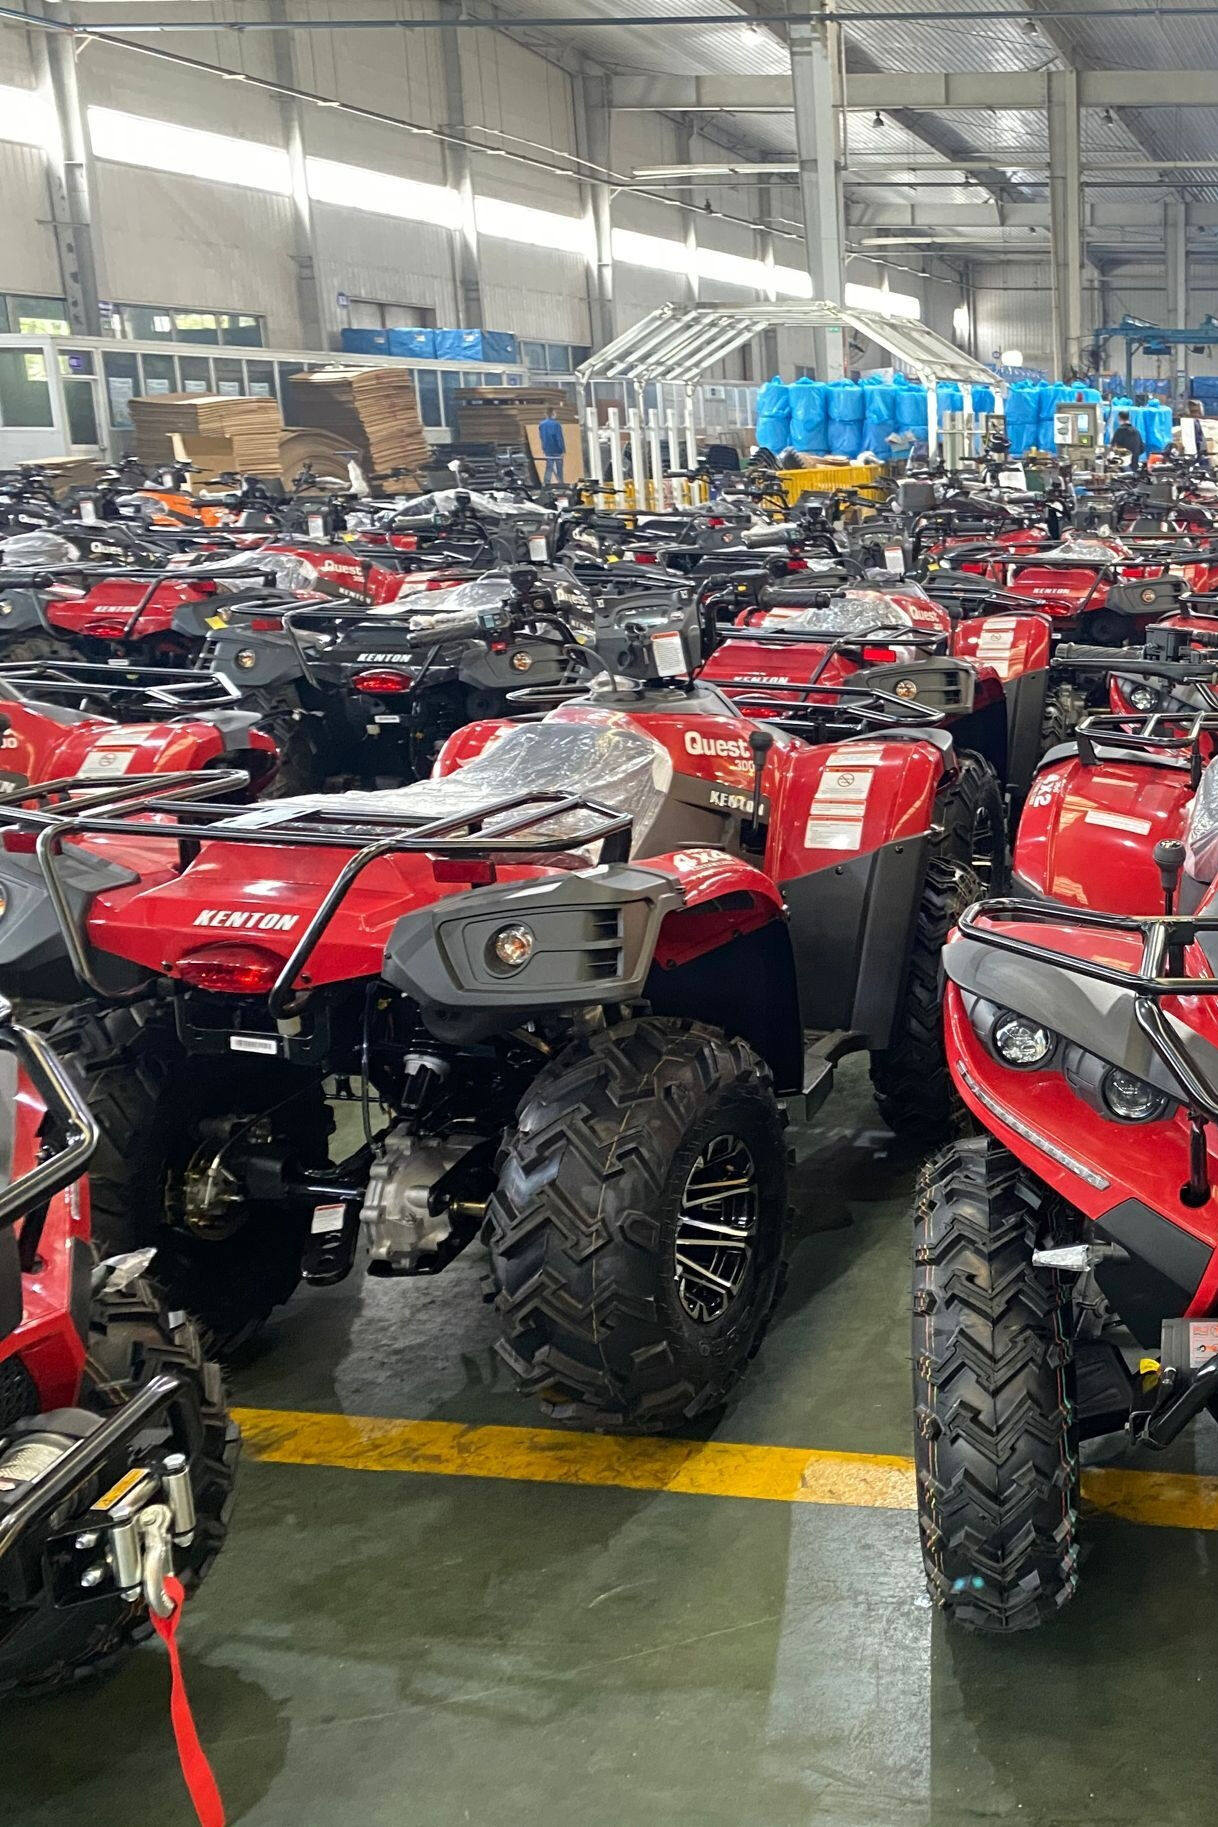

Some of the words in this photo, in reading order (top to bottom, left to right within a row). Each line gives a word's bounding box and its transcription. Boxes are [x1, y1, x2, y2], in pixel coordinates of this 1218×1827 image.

[323, 560, 363, 577] Quest
[909, 605, 940, 622] Quest
[356, 653, 413, 663] KENTON
[684, 730, 751, 758] Quest
[192, 909, 300, 931] KENTON
